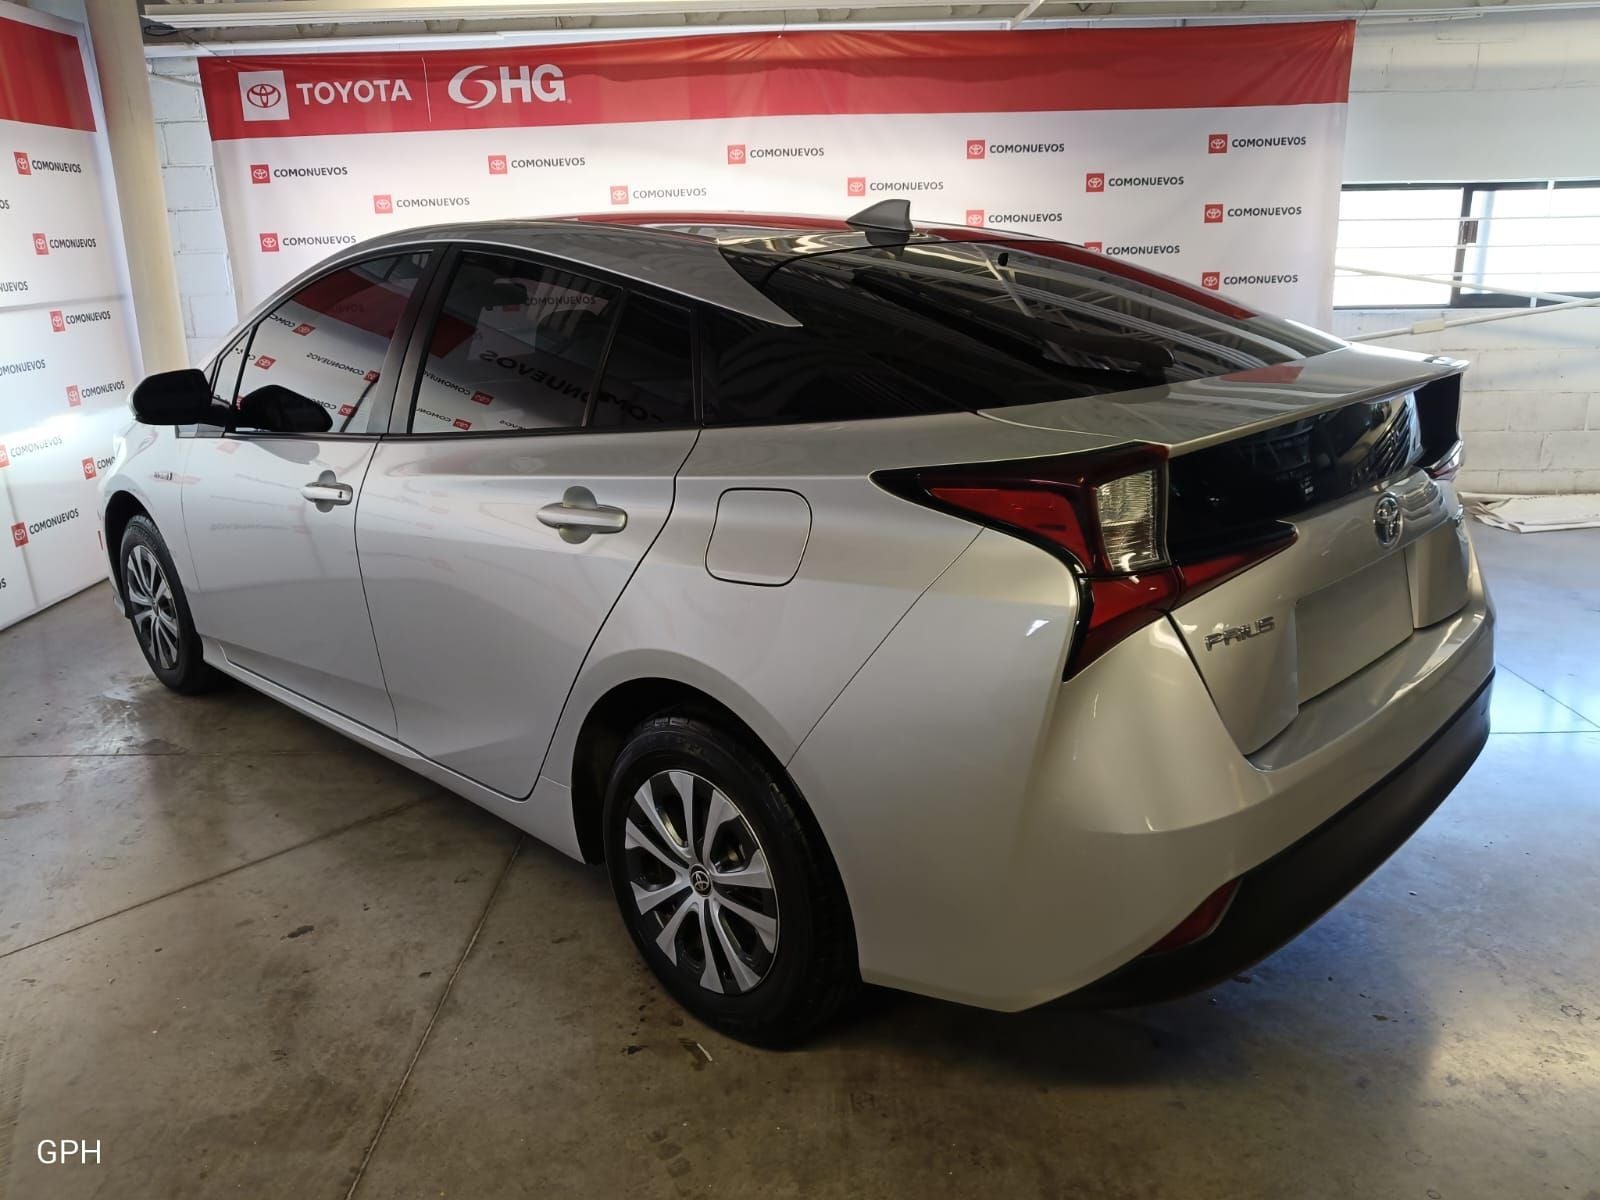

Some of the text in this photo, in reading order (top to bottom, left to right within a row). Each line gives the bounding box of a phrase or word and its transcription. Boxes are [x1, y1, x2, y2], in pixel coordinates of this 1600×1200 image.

[296, 80, 412, 105] TOYOTA
[1232, 136, 1306, 148] COMONUEVOS
[750, 147, 825, 159] COMONUEVOS
[990, 143, 1065, 154] COMONUEVOS
[32, 160, 81, 173] COMONUEVOS
[512, 157, 586, 169] COMONUEVOS
[274, 166, 348, 178] COMONUEVOS
[870, 181, 944, 192] COMONUEVOS
[1108, 176, 1185, 187] COMONUEVOS
[633, 187, 707, 199] COMONUEVOS
[396, 197, 470, 208] COMONUEVOS
[1227, 206, 1302, 217] COMONUEVOS
[988, 213, 1063, 223] COMONUEVOS
[49, 238, 97, 249] COMONUEVOS
[282, 235, 357, 246] COMONUEVOS
[1106, 245, 1180, 256] COMONUEVOS
[1223, 274, 1298, 285] COMONUEVOS
[65, 311, 111, 325] COMONUEVOS
[81, 380, 126, 398] COMONUEVOS
[10, 436, 63, 458] COMONUEVOS
[29, 508, 80, 535] COMONUEVOS
[1204, 616, 1275, 652] PRIUS
